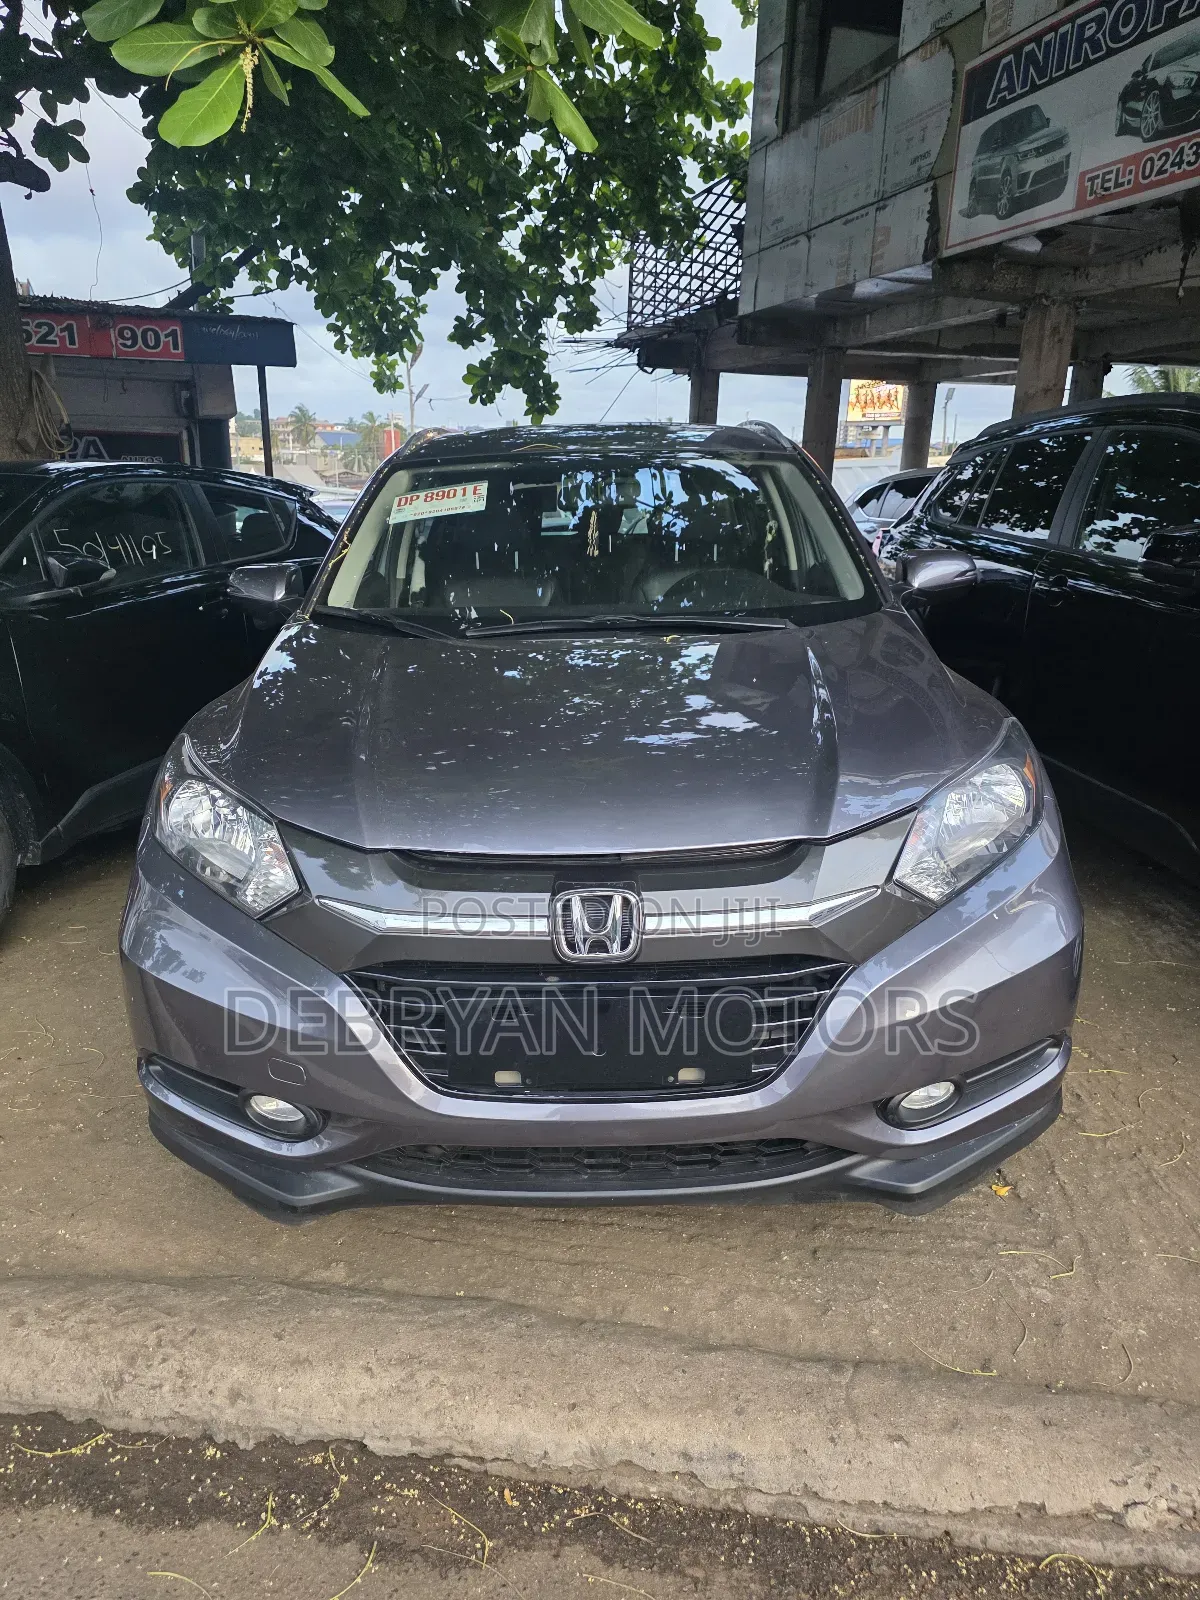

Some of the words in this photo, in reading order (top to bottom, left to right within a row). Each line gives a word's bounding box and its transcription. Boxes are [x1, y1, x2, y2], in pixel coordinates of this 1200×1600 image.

[1085, 161, 1135, 201] TEL:
[115, 324, 182, 353] 901
[396, 494, 420, 508] DP
[423, 486, 467, 503] 8901
